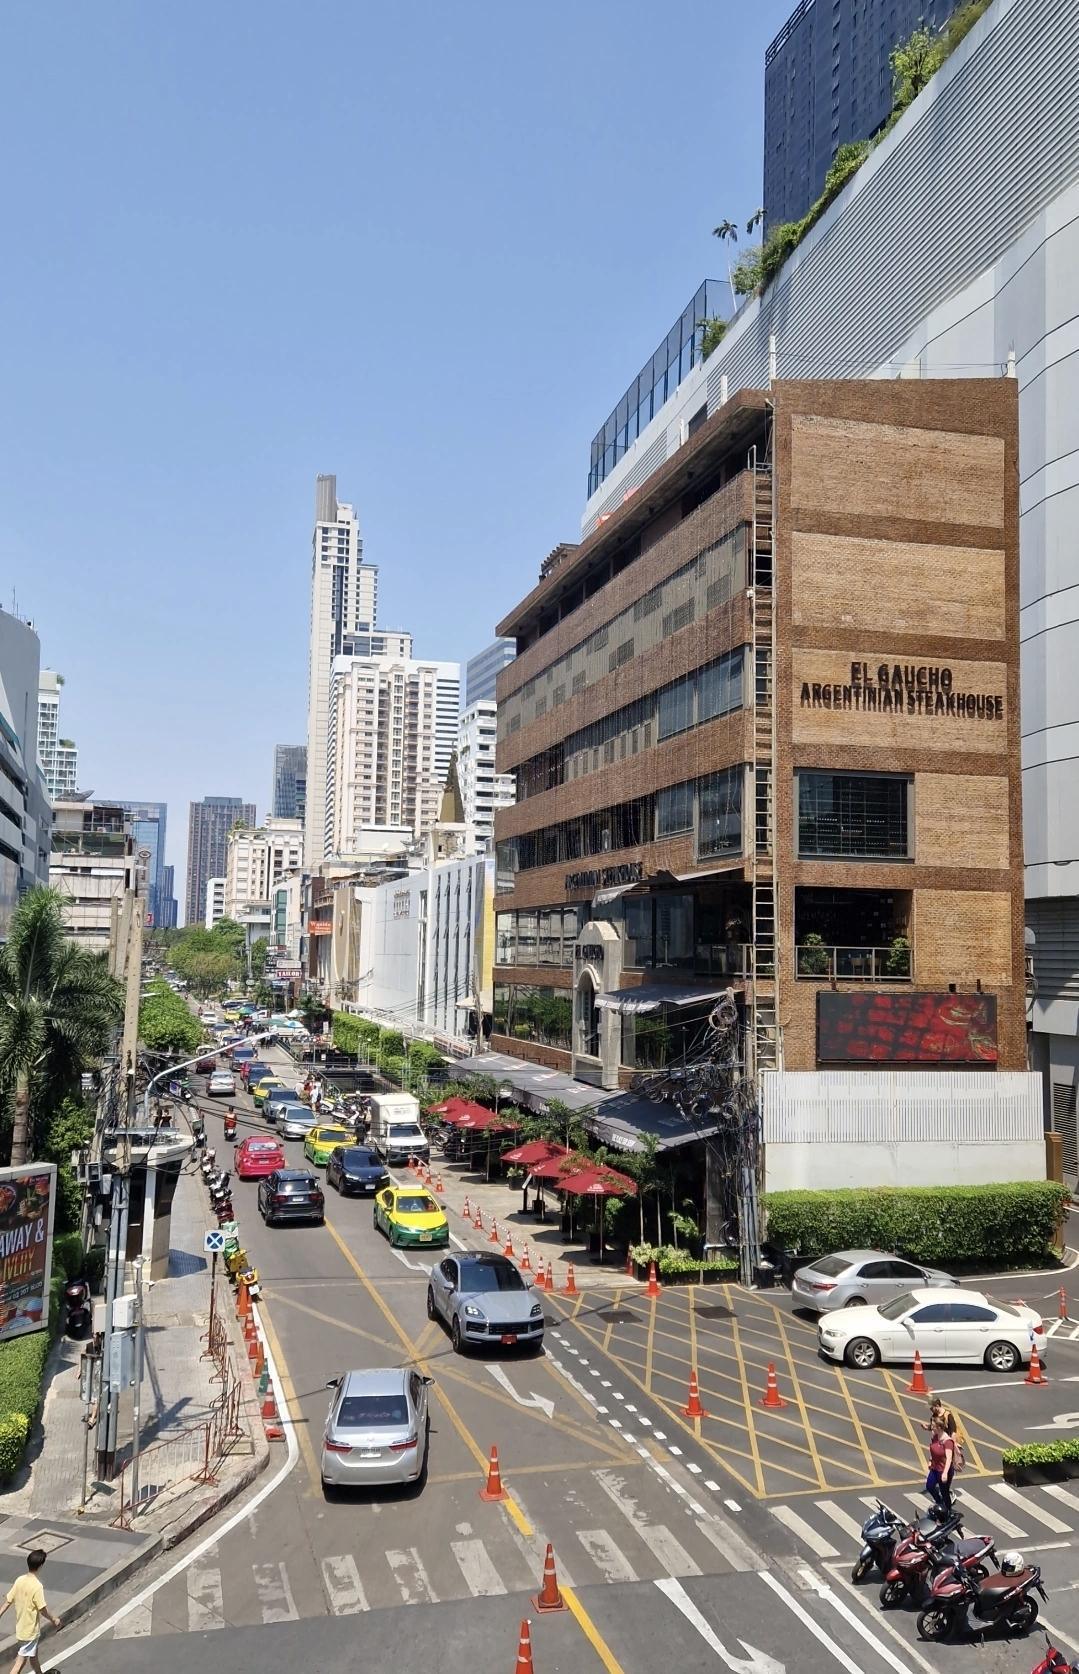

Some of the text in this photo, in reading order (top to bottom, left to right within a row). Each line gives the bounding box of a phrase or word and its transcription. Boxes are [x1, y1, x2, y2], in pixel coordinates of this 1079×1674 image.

[851, 662, 953, 689] EL GAUCHO
[801, 682, 1003, 715] ARGENTINIAN STEAKHOUSE
[34, 1217, 44, 1243] &
